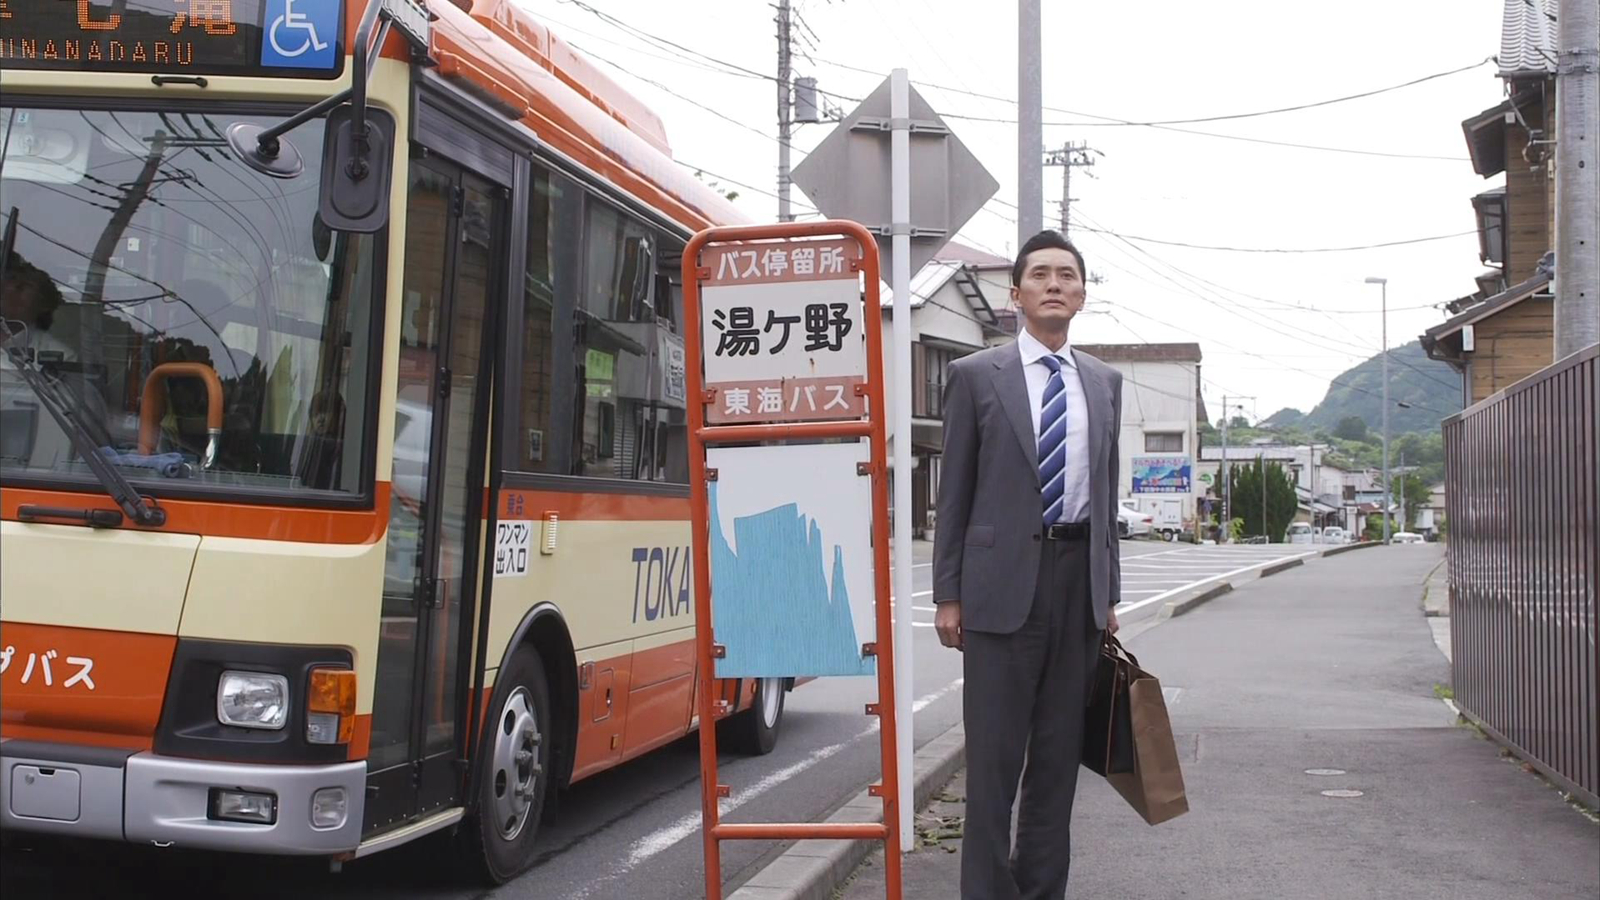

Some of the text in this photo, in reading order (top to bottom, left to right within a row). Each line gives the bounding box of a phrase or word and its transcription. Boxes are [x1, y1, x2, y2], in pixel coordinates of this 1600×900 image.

[717, 246, 844, 281] バス停留所
[723, 384, 850, 415] 東海バス
[497, 523, 530, 545] ワンマン
[495, 548, 527, 575] 出入口
